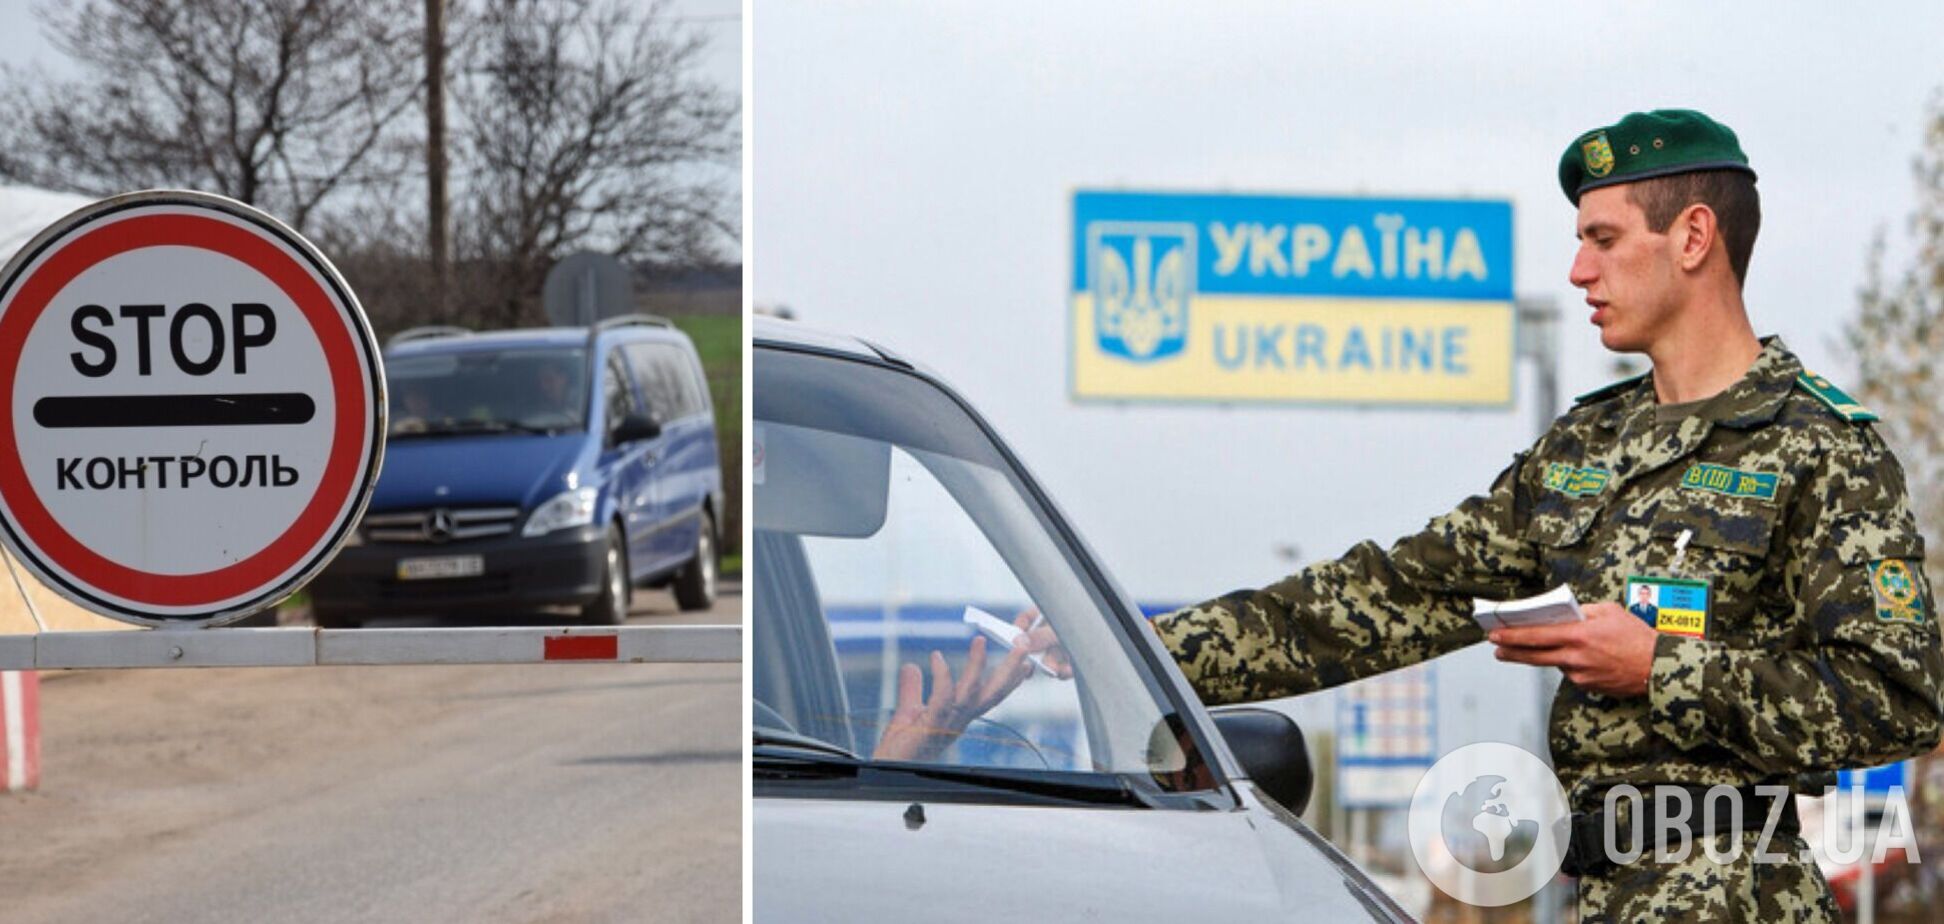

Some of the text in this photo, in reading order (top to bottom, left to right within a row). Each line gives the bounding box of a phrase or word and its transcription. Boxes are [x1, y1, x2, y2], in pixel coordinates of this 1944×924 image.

[1208, 213, 1488, 280] УКРАЇНА
[70, 303, 277, 377] STOP
[1212, 324, 1470, 375] UKRAINE
[57, 455, 299, 490] КОНТРОЛЬ
